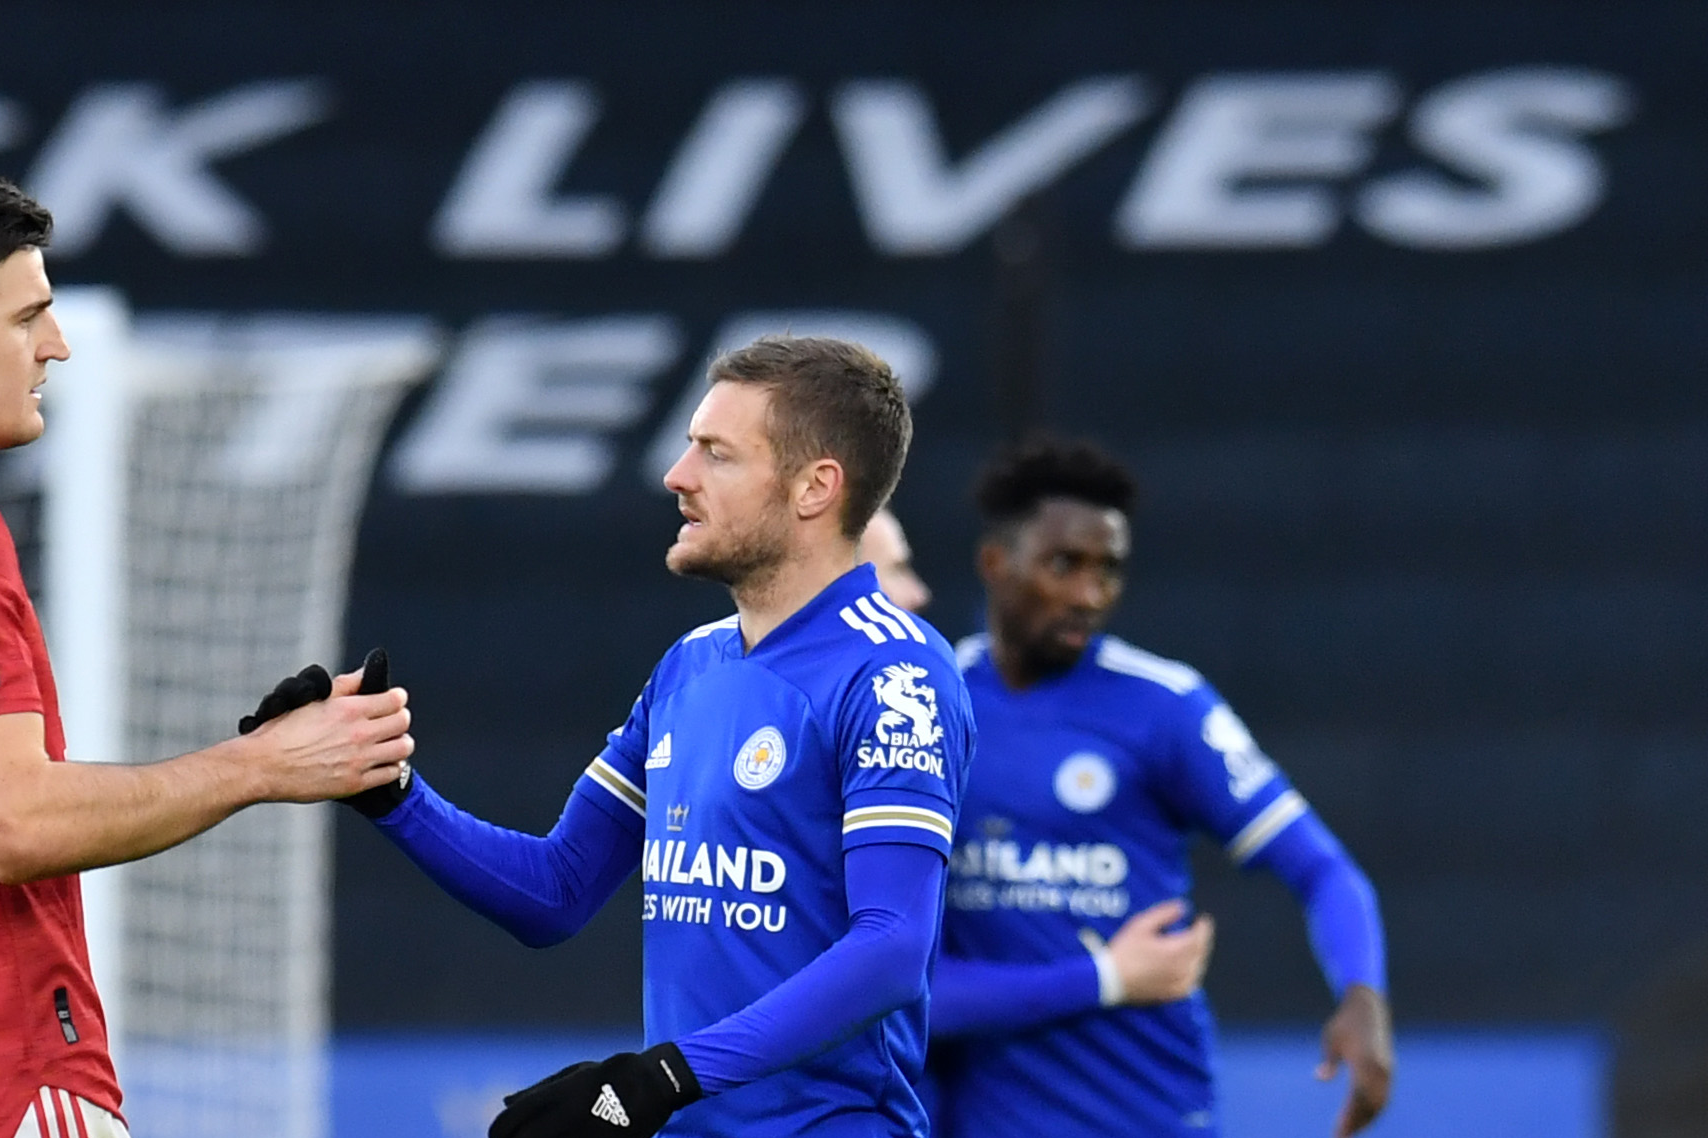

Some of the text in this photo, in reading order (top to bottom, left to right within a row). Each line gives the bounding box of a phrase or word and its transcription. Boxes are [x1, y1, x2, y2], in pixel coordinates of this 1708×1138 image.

[432, 70, 1632, 257] LIVES
[890, 732, 920, 748] BIA
[857, 747, 944, 779] SAIGON
[662, 895, 713, 925] WITH
[722, 901, 786, 933] YOU
